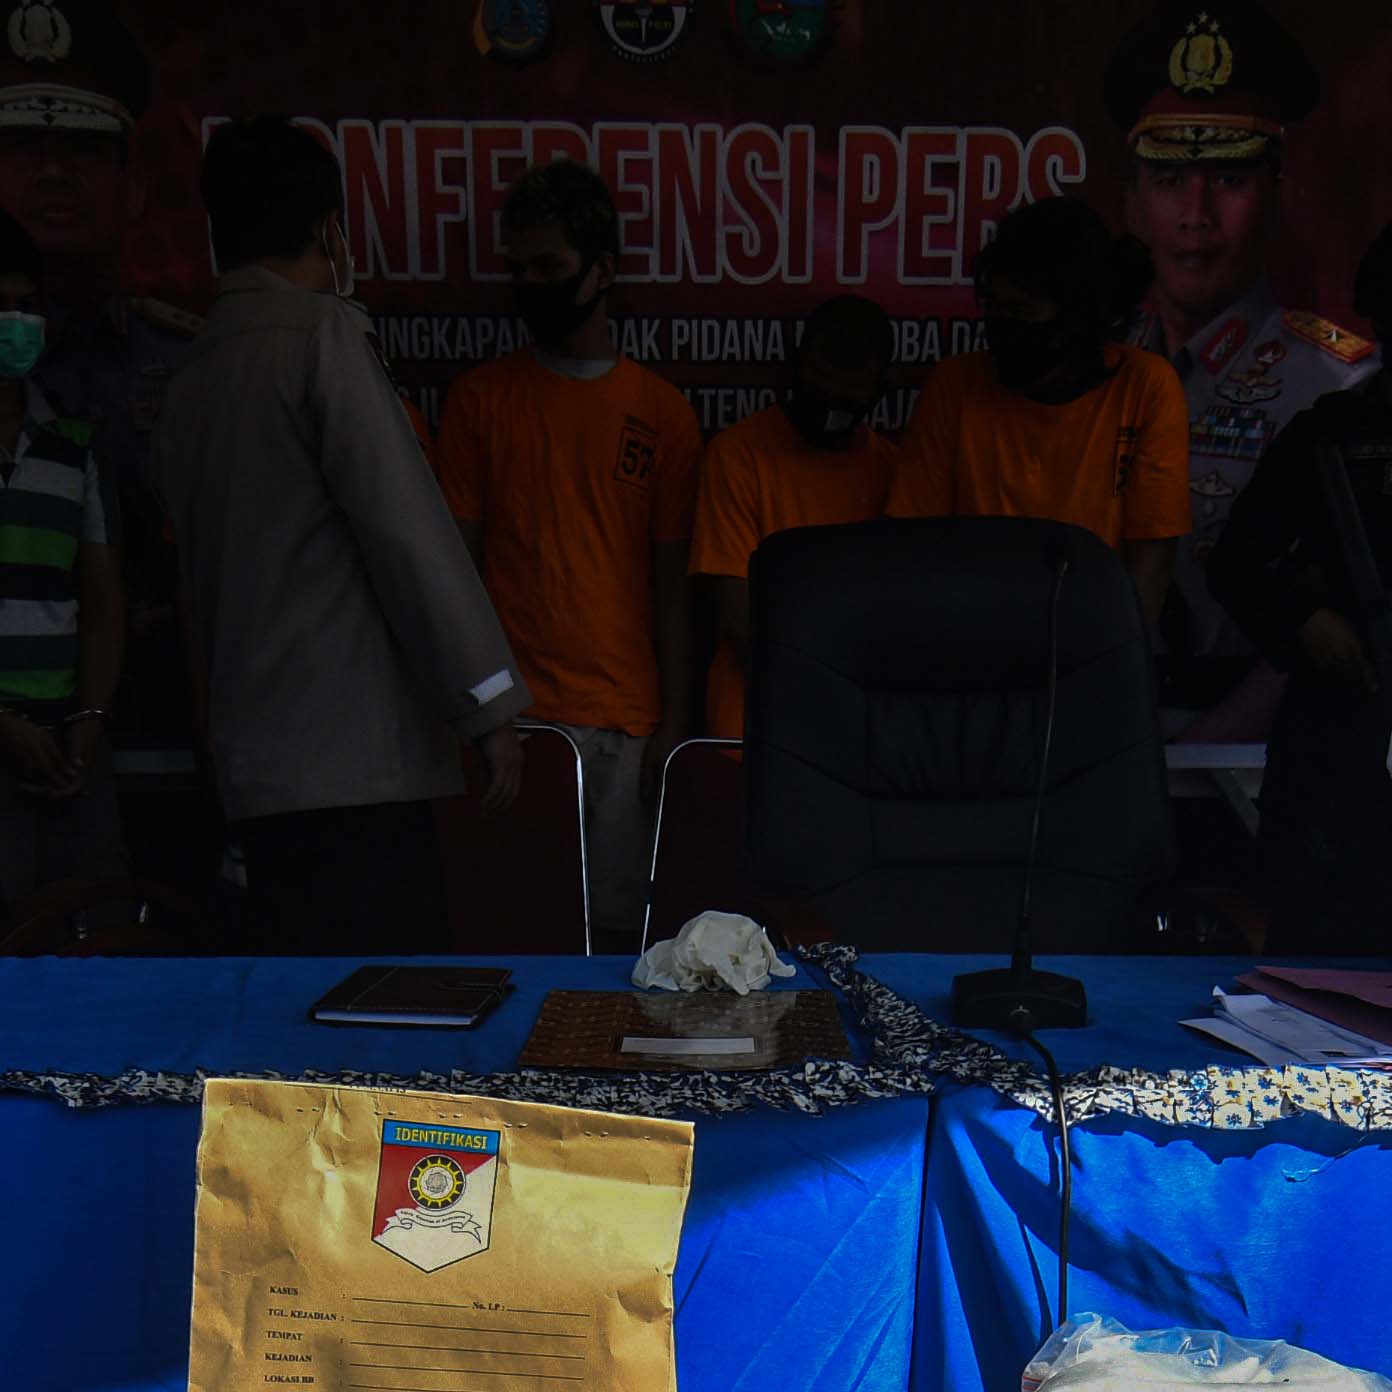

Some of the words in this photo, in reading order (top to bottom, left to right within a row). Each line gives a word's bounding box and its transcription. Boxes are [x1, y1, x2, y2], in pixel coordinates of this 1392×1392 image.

[202, 116, 815, 286] NFEENSI
[670, 318, 785, 361] PIDANA
[395, 1126, 488, 1150] IDENTIFIKASI
[269, 1285, 299, 1296] KASUS
[290, 1309, 337, 1321] KEJADIAN
[267, 1330, 303, 1341] TEMPAT
[264, 1352, 313, 1363] KEJADIAN
